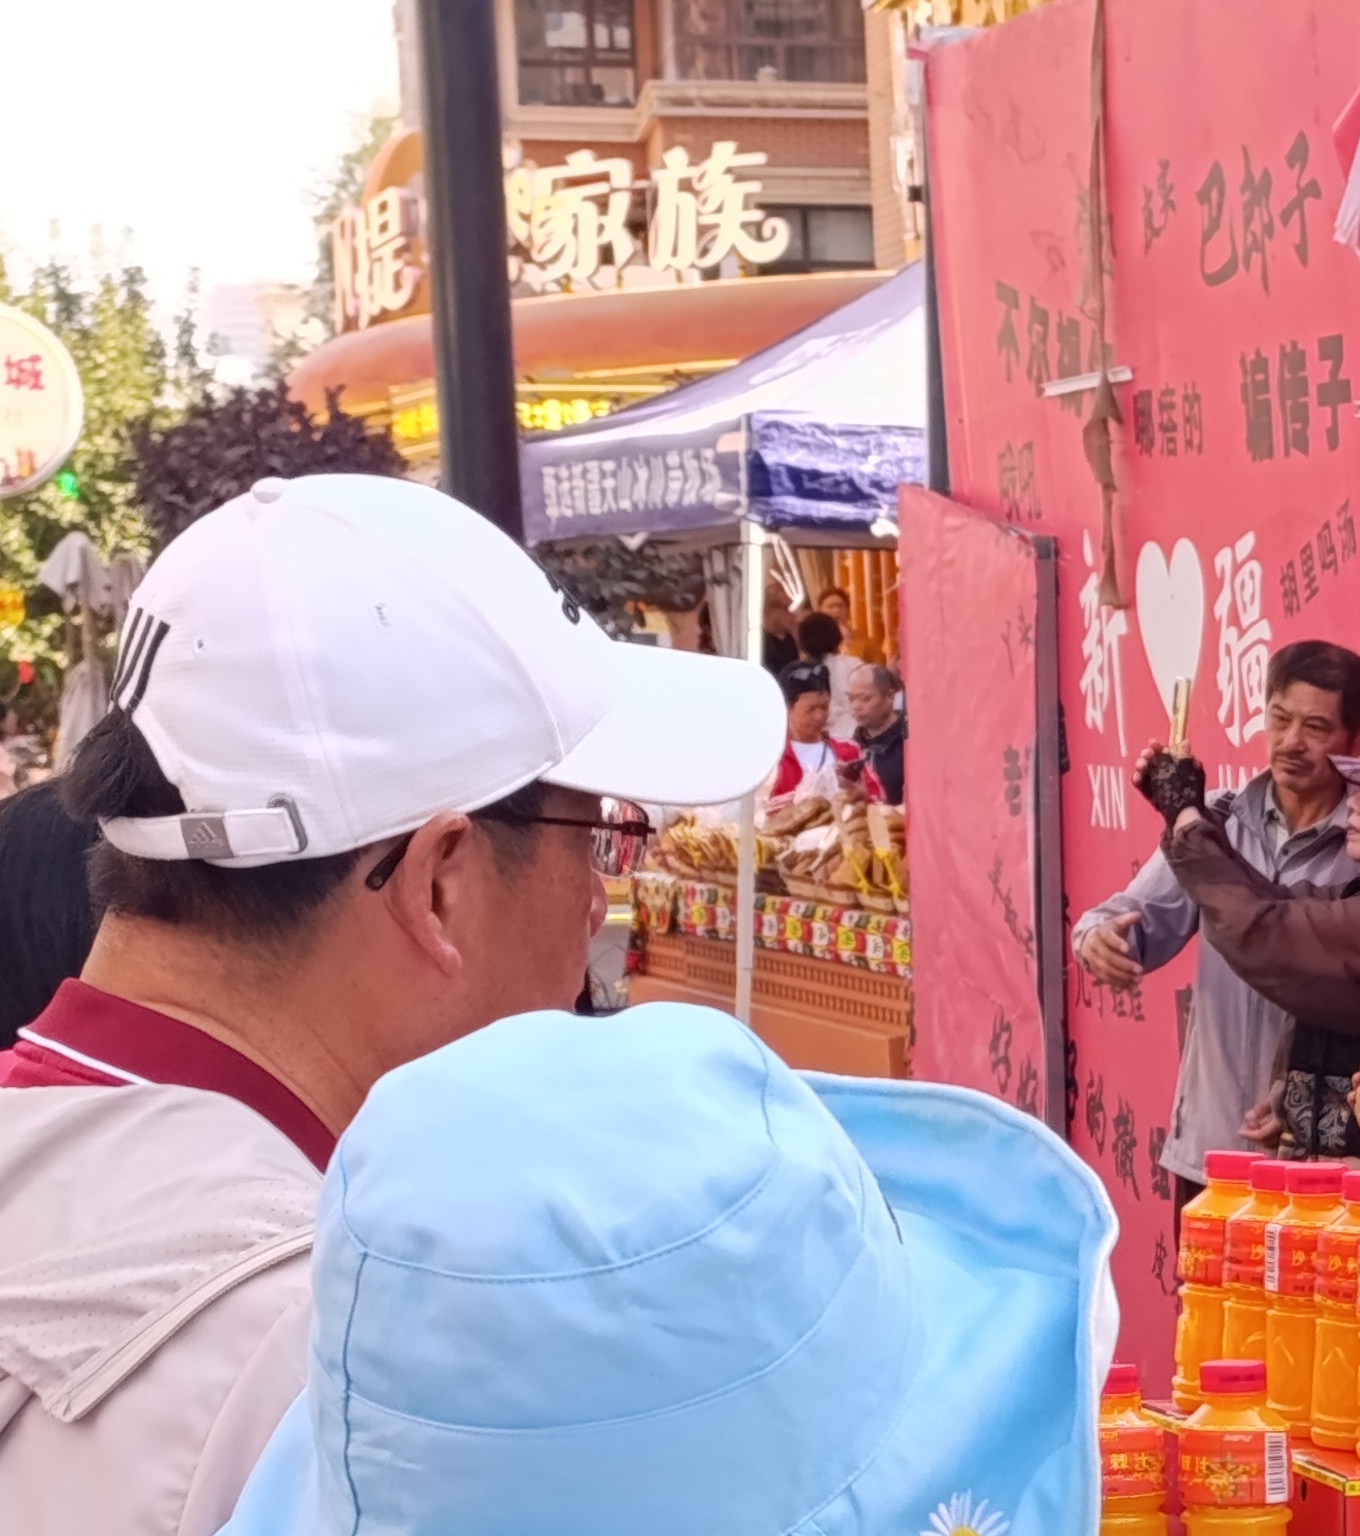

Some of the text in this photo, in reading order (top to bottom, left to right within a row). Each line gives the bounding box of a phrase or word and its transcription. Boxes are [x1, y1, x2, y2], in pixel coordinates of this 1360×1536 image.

[1194, 130, 1322, 298] 巴郎子
[1078, 529, 1130, 758] 新
[1087, 764, 1128, 831] XIN
